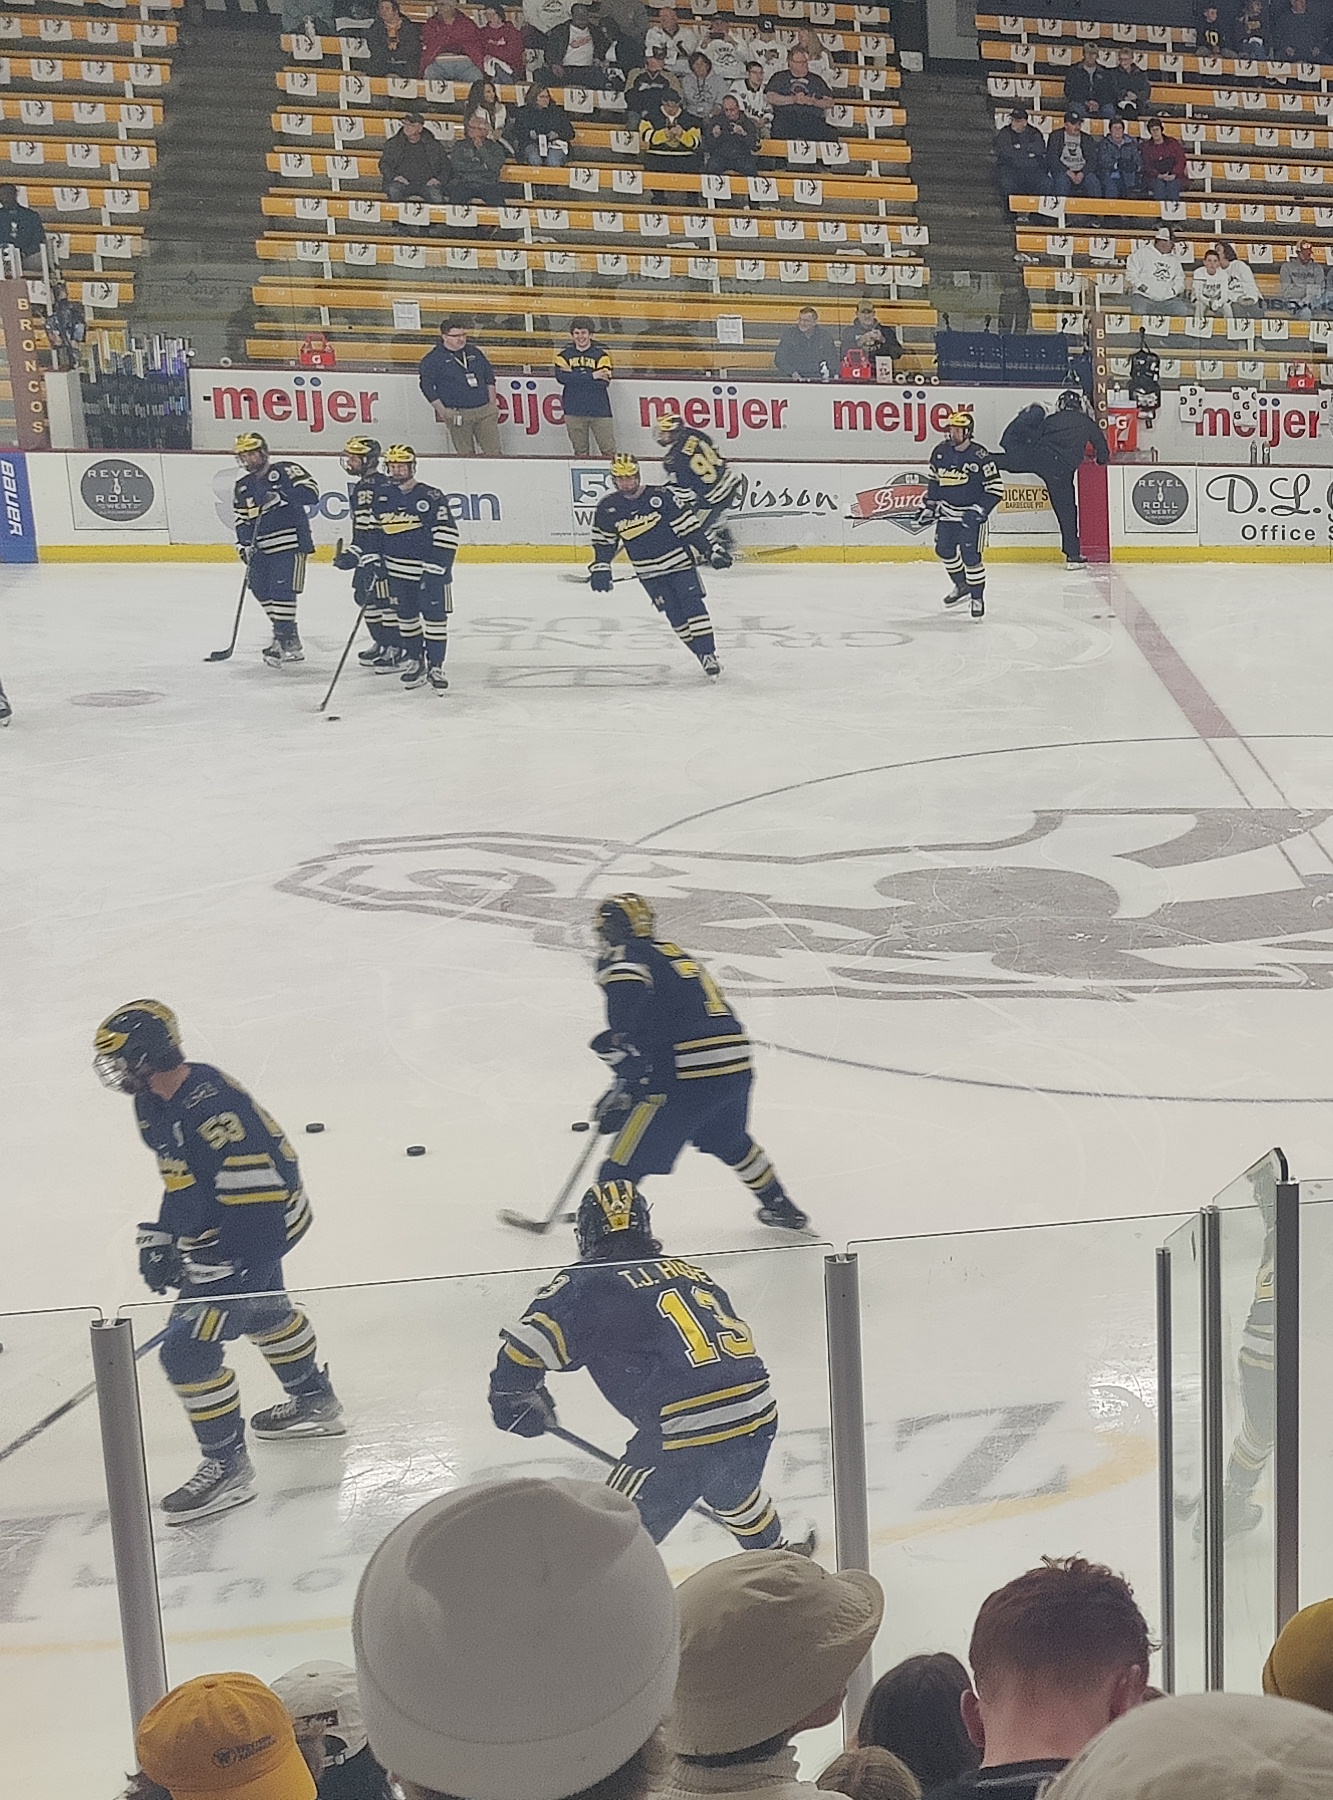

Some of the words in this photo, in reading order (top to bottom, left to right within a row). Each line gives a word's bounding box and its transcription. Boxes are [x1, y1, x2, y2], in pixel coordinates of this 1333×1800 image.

[17, 298, 44, 434] BRONCOS
[1095, 327, 1109, 431] BRONCO
[212, 376, 379, 433] meijer
[638, 385, 788, 440] meijer
[87, 469, 144, 479] REVEL
[1138, 479, 1183, 488] REVEL
[95, 494, 142, 503] ROLL
[1001, 487, 1049, 502] DICKEY'S
[1142, 501, 1179, 510] ROLL
[1241, 524, 1316, 541] Office
[196, 1111, 247, 1151] 53
[617, 1266, 661, 1290] T.J.
[656, 1285, 757, 1369] 13
